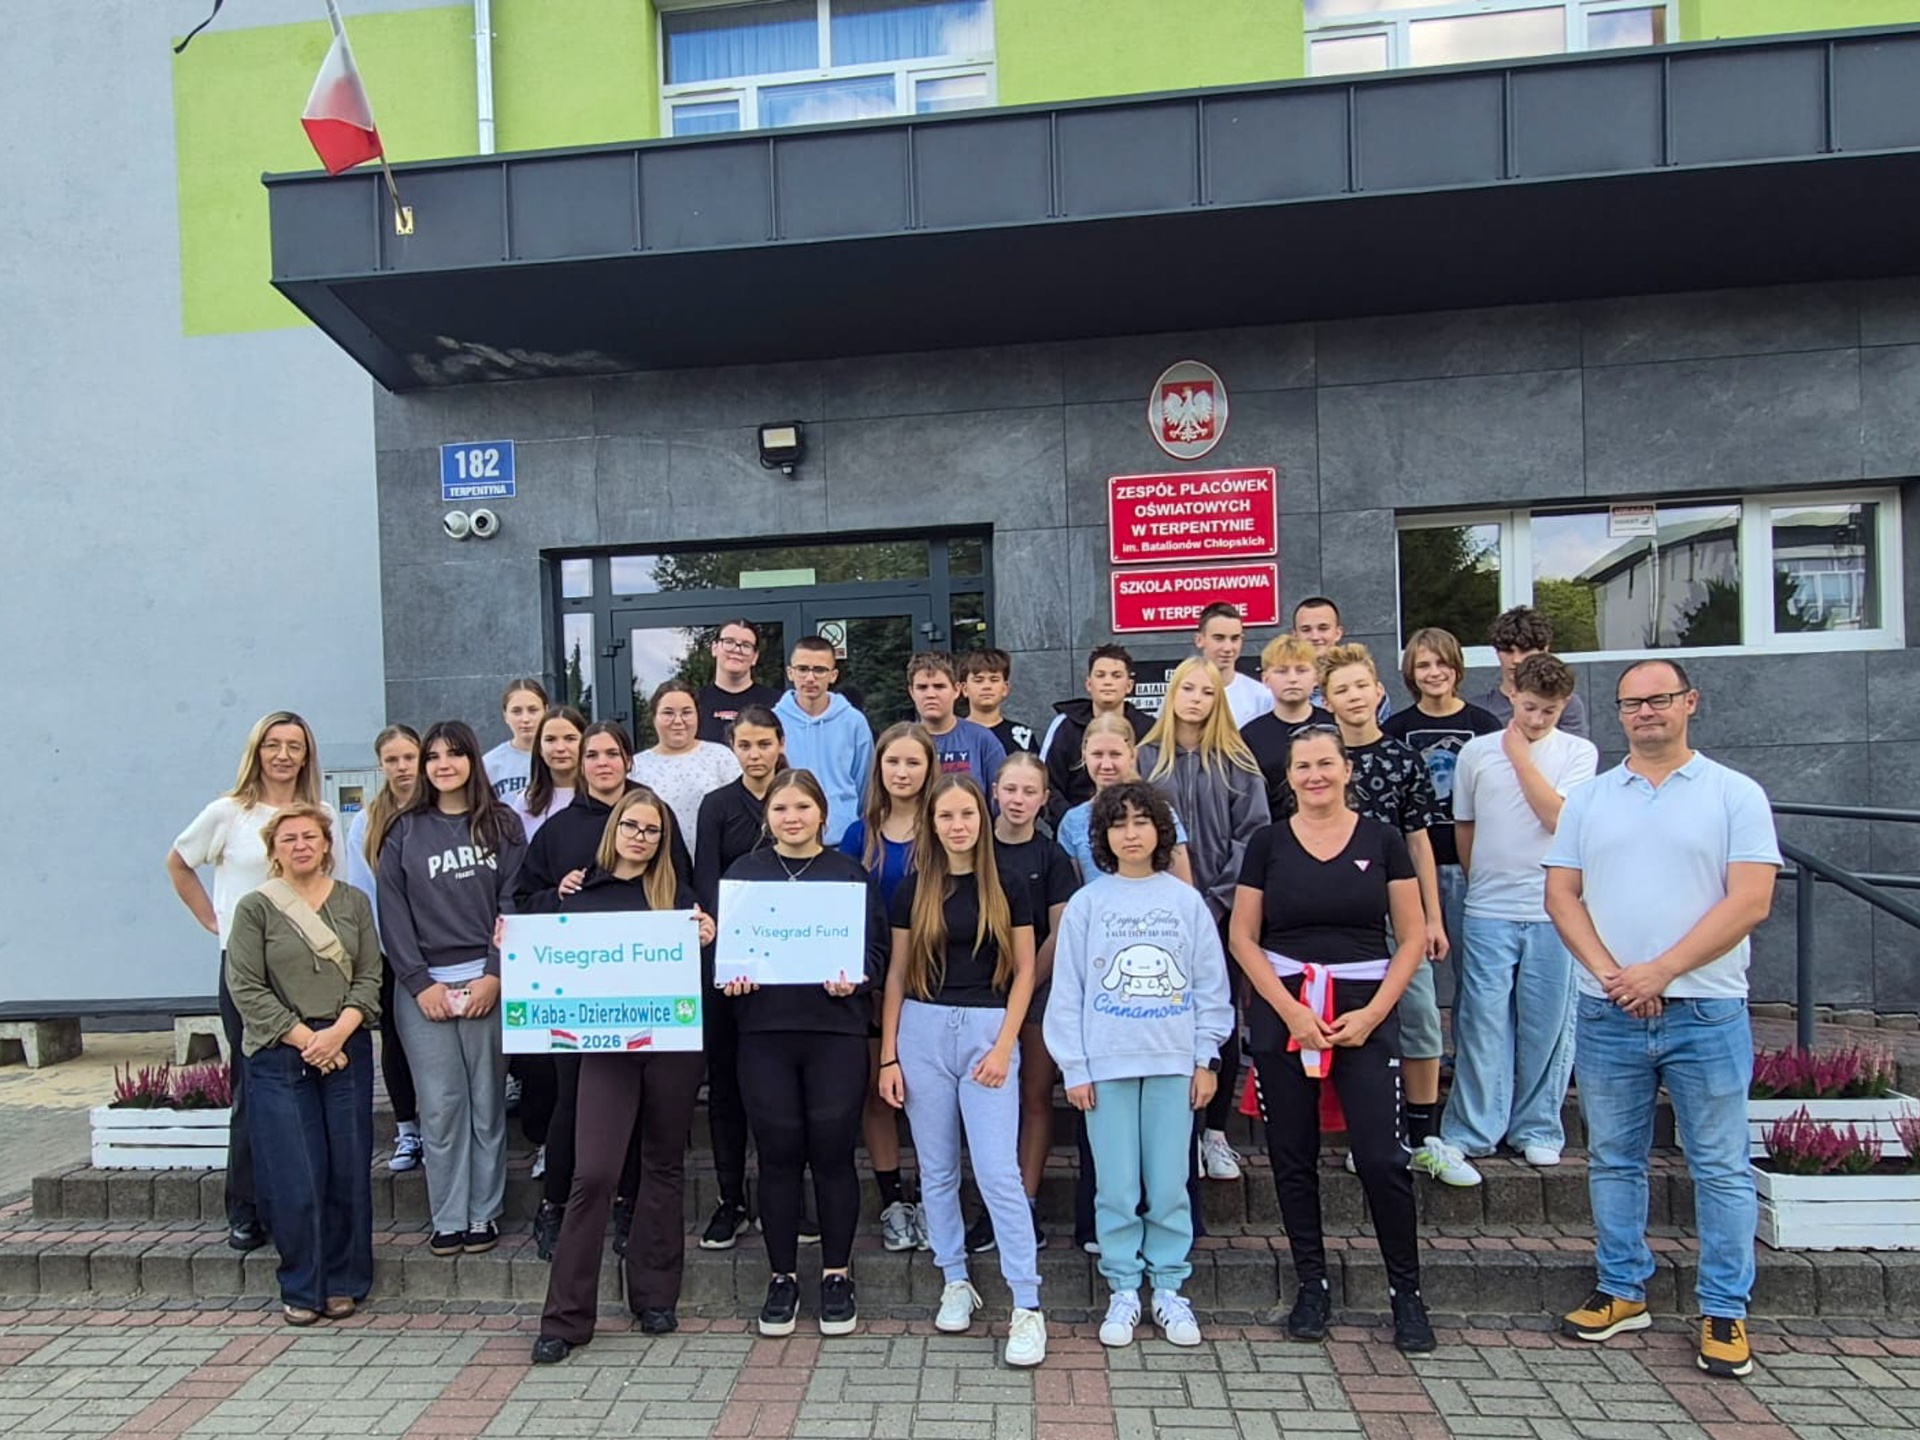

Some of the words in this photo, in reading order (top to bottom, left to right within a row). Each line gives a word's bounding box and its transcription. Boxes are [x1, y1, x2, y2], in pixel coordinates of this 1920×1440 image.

[454, 448, 500, 479] 182
[450, 485, 507, 497] TERPENTYNA
[1116, 482, 1177, 499] ZESPÓŁ
[1180, 478, 1269, 496] PLACÓWEK
[1134, 499, 1251, 518] OŚWIATOWYCH
[1131, 523, 1147, 537] W
[1149, 518, 1255, 536] TERPENTYNIE
[1122, 542, 1140, 553] im.
[1141, 539, 1202, 552] Batalionów
[1174, 574, 1270, 592] PODSTAWOWA
[1141, 607, 1155, 621] W
[428, 845, 498, 879] PARIS
[752, 925, 811, 941] Visegrad
[816, 924, 849, 938] Fund
[533, 943, 624, 969] Visegrad
[632, 942, 683, 963] Fund
[531, 1003, 566, 1025] Kaba
[579, 1001, 671, 1023] Dzierzkowice
[582, 1034, 621, 1049] 2026
